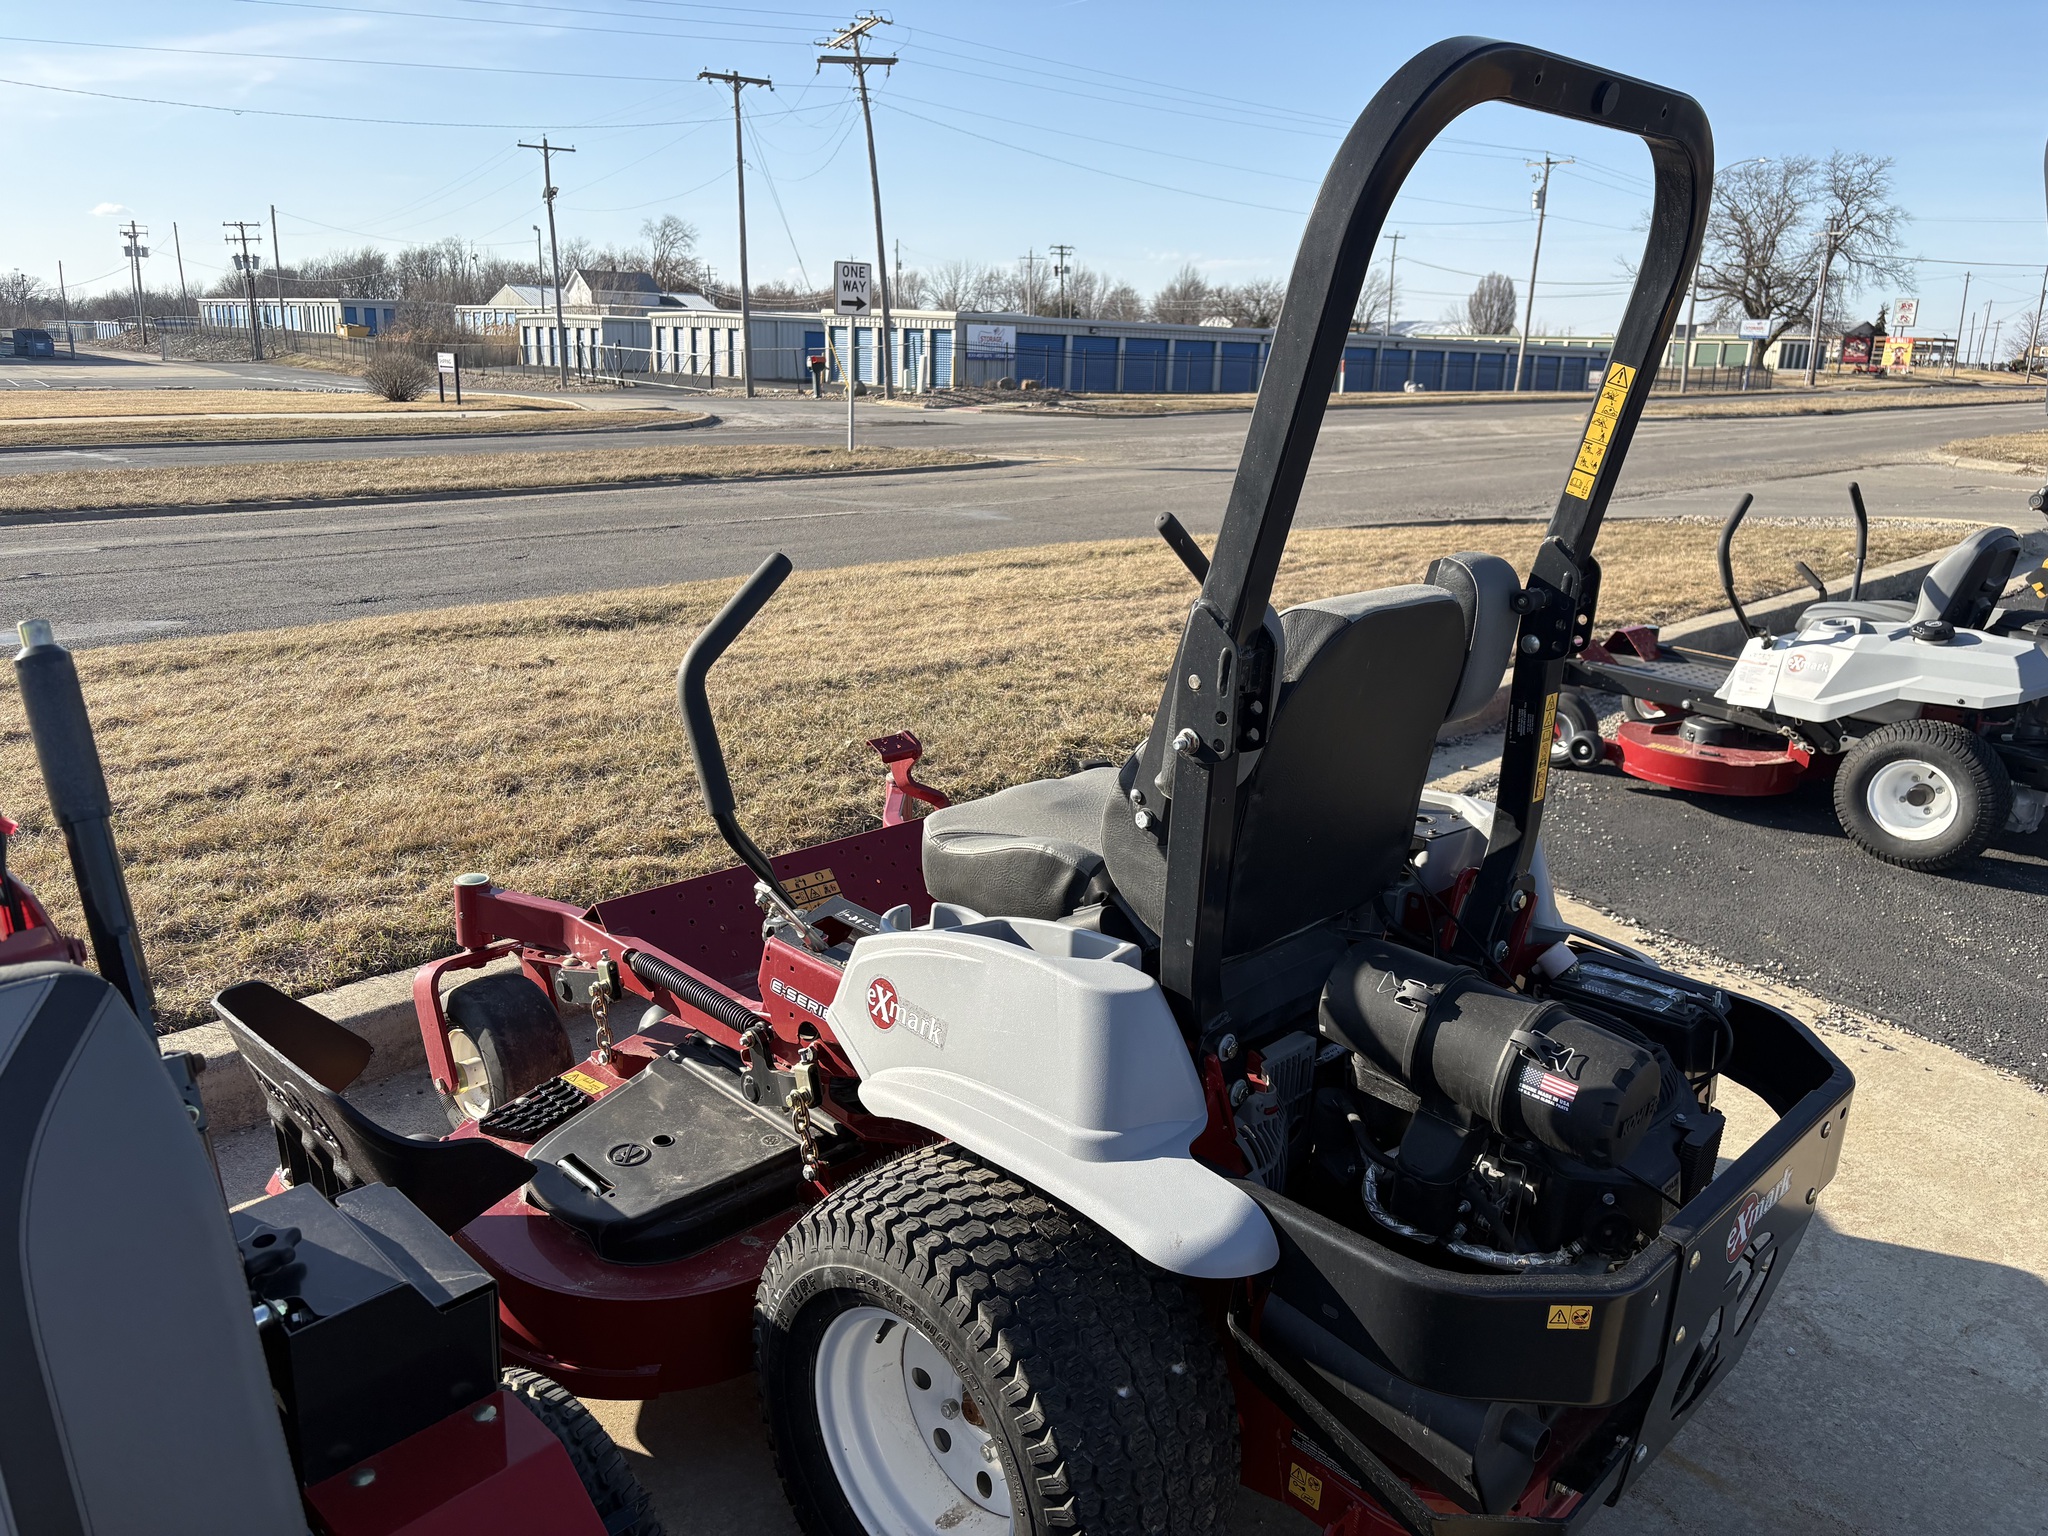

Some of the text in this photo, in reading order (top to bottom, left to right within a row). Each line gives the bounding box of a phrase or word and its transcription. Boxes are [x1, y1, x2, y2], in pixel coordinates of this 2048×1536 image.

[842, 265, 866, 279] ONE
[842, 280, 867, 293] WAY
[770, 978, 830, 1021] E-SERI
[1555, 1102, 1569, 1112] PARTS
[1559, 1099, 1570, 1108] USA
[785, 1272, 817, 1308] TURF
